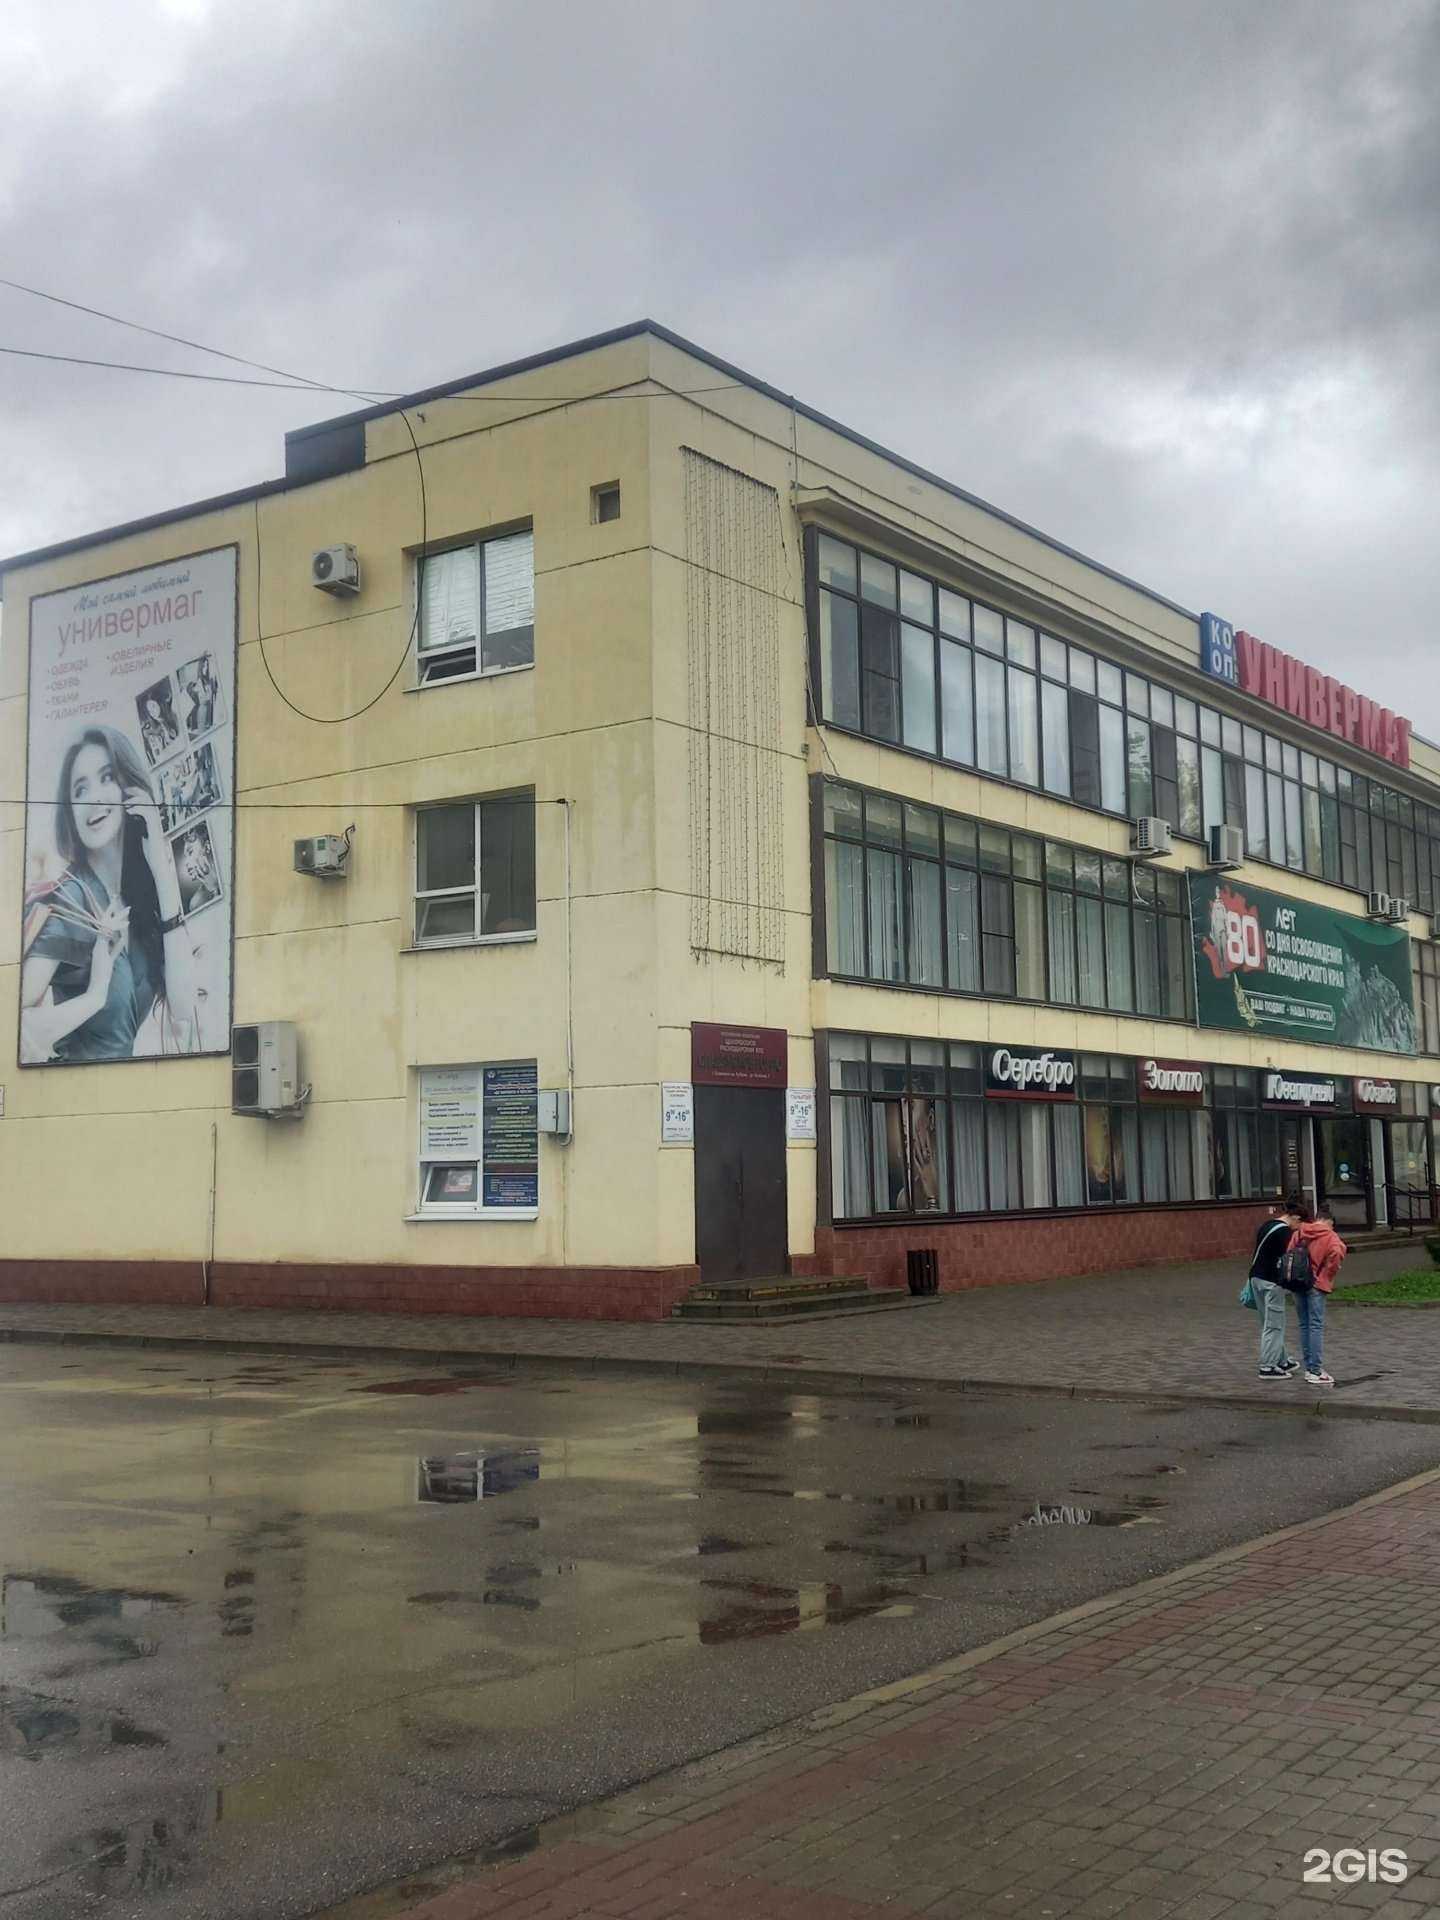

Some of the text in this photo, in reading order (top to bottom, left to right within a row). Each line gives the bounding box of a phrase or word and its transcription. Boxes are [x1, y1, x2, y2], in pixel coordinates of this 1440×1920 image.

[58, 590, 202, 657] универмаг
[51, 700, 109, 720] ГАЛАНТЕРЕЯ
[1227, 910, 1261, 968] 80
[1266, 930, 1343, 965] СО ДНЯ ОСВОБОЖДЕНИЯ
[1267, 954, 1344, 988] КРАСНОДАРСКОГО КРАЯ
[993, 1049, 1074, 1092] Серебро
[1144, 1061, 1203, 1092] Золото
